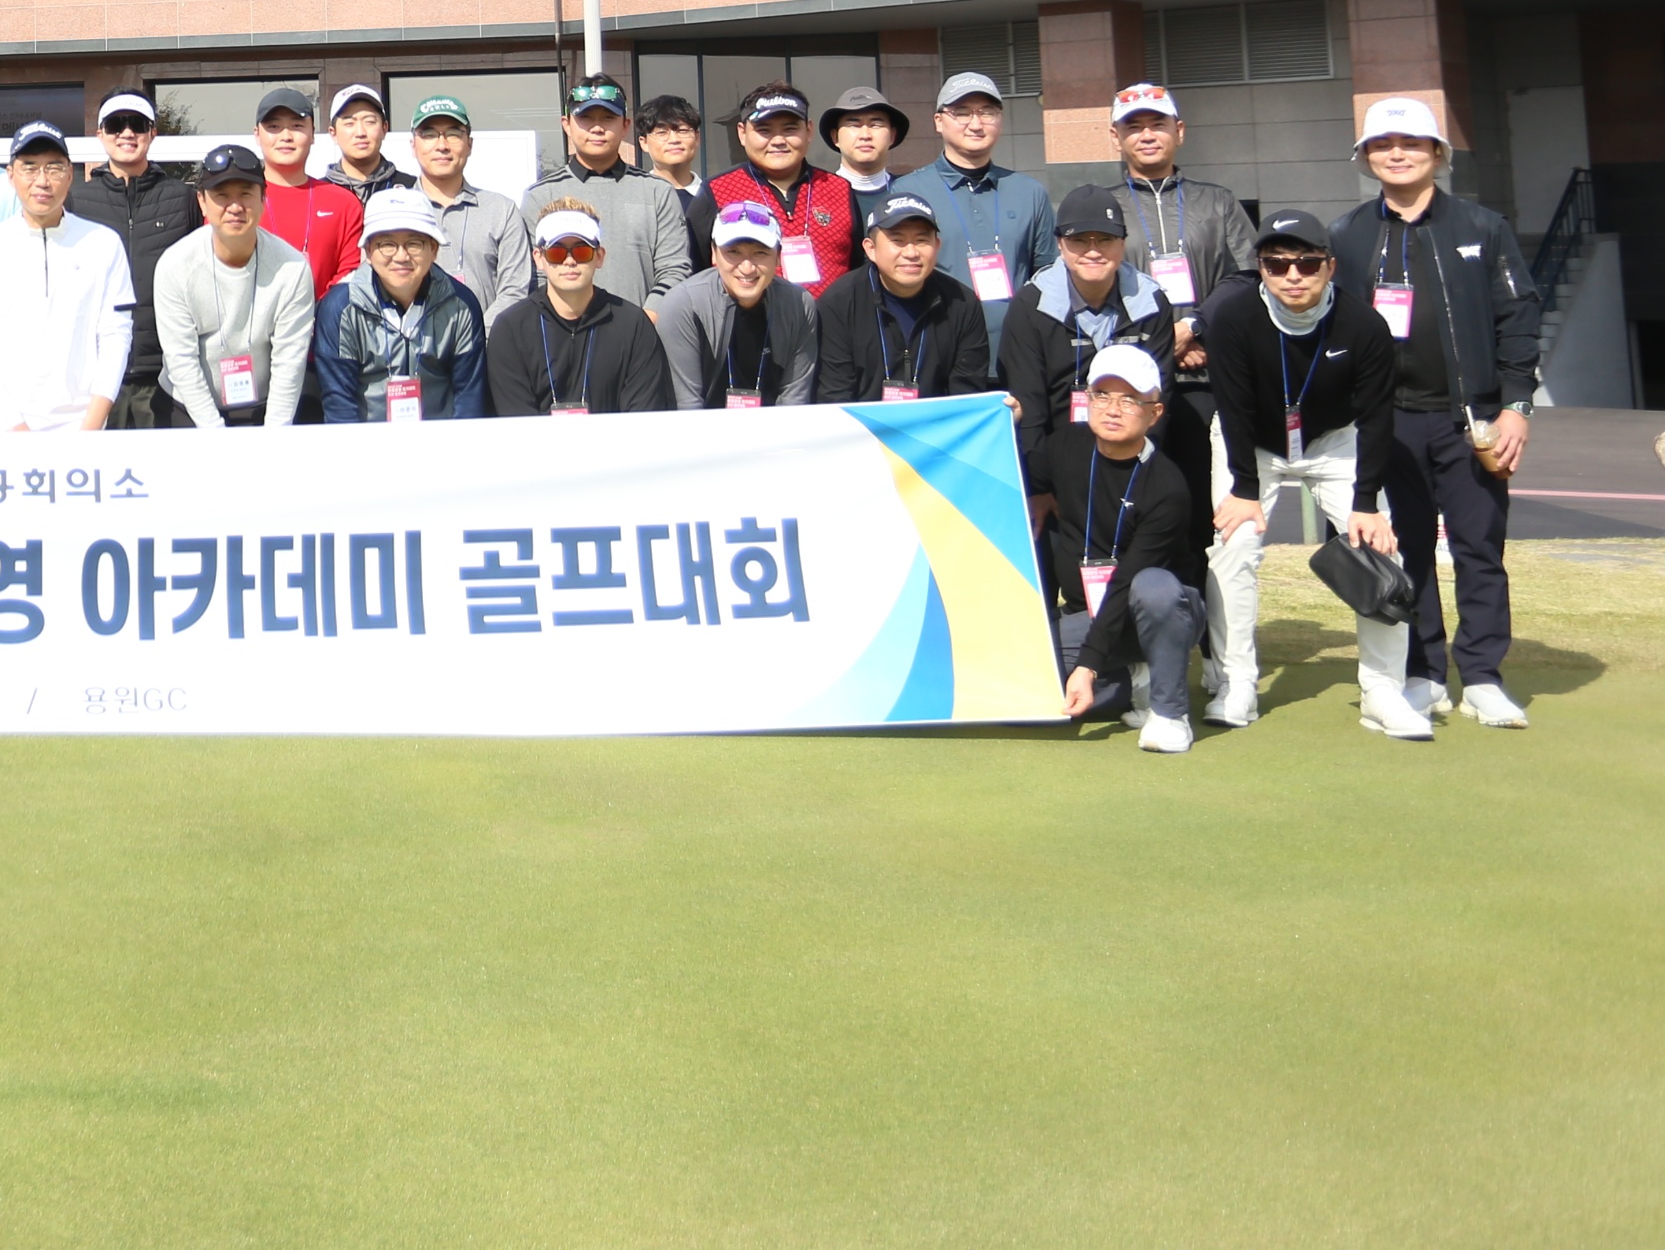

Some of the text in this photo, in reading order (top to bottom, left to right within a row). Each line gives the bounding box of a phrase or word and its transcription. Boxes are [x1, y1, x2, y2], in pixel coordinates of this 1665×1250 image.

[80, 530, 426, 641] 아카데미
[458, 517, 810, 635] 골프대회
[83, 687, 188, 714] 용원GC
